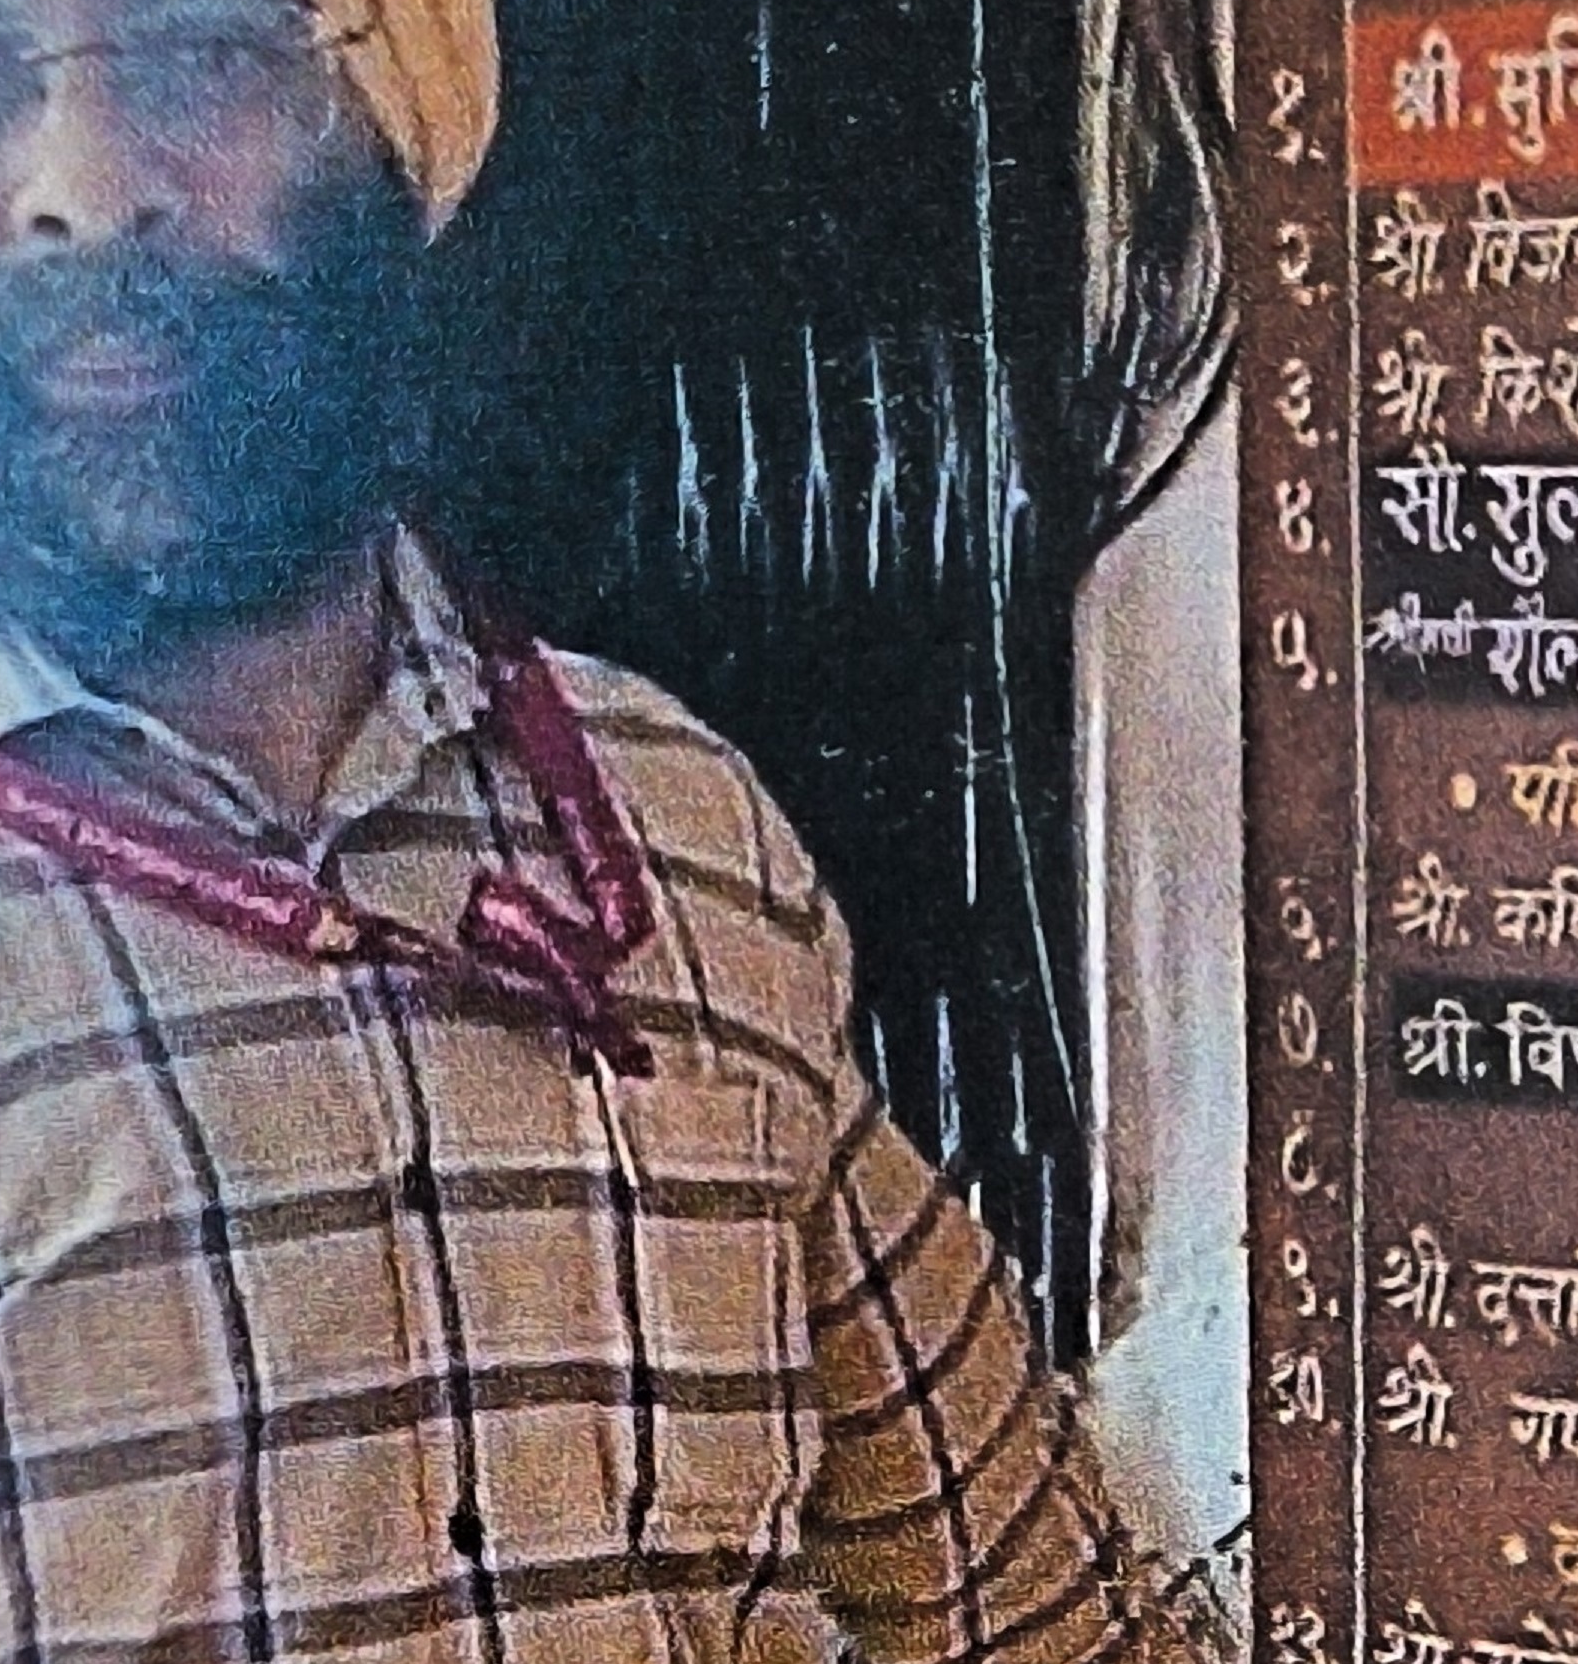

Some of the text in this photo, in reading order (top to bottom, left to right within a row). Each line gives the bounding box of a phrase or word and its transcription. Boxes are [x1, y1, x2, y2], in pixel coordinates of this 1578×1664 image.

[1391, 27, 1487, 135] श्री.
[1373, 437, 1479, 553] सौ.
[1389, 849, 1473, 949] श्री.
[1401, 997, 1489, 1085] श्री.
[1377, 1223, 1457, 1331] श्री.
[1375, 1341, 1459, 1449] श्री.
